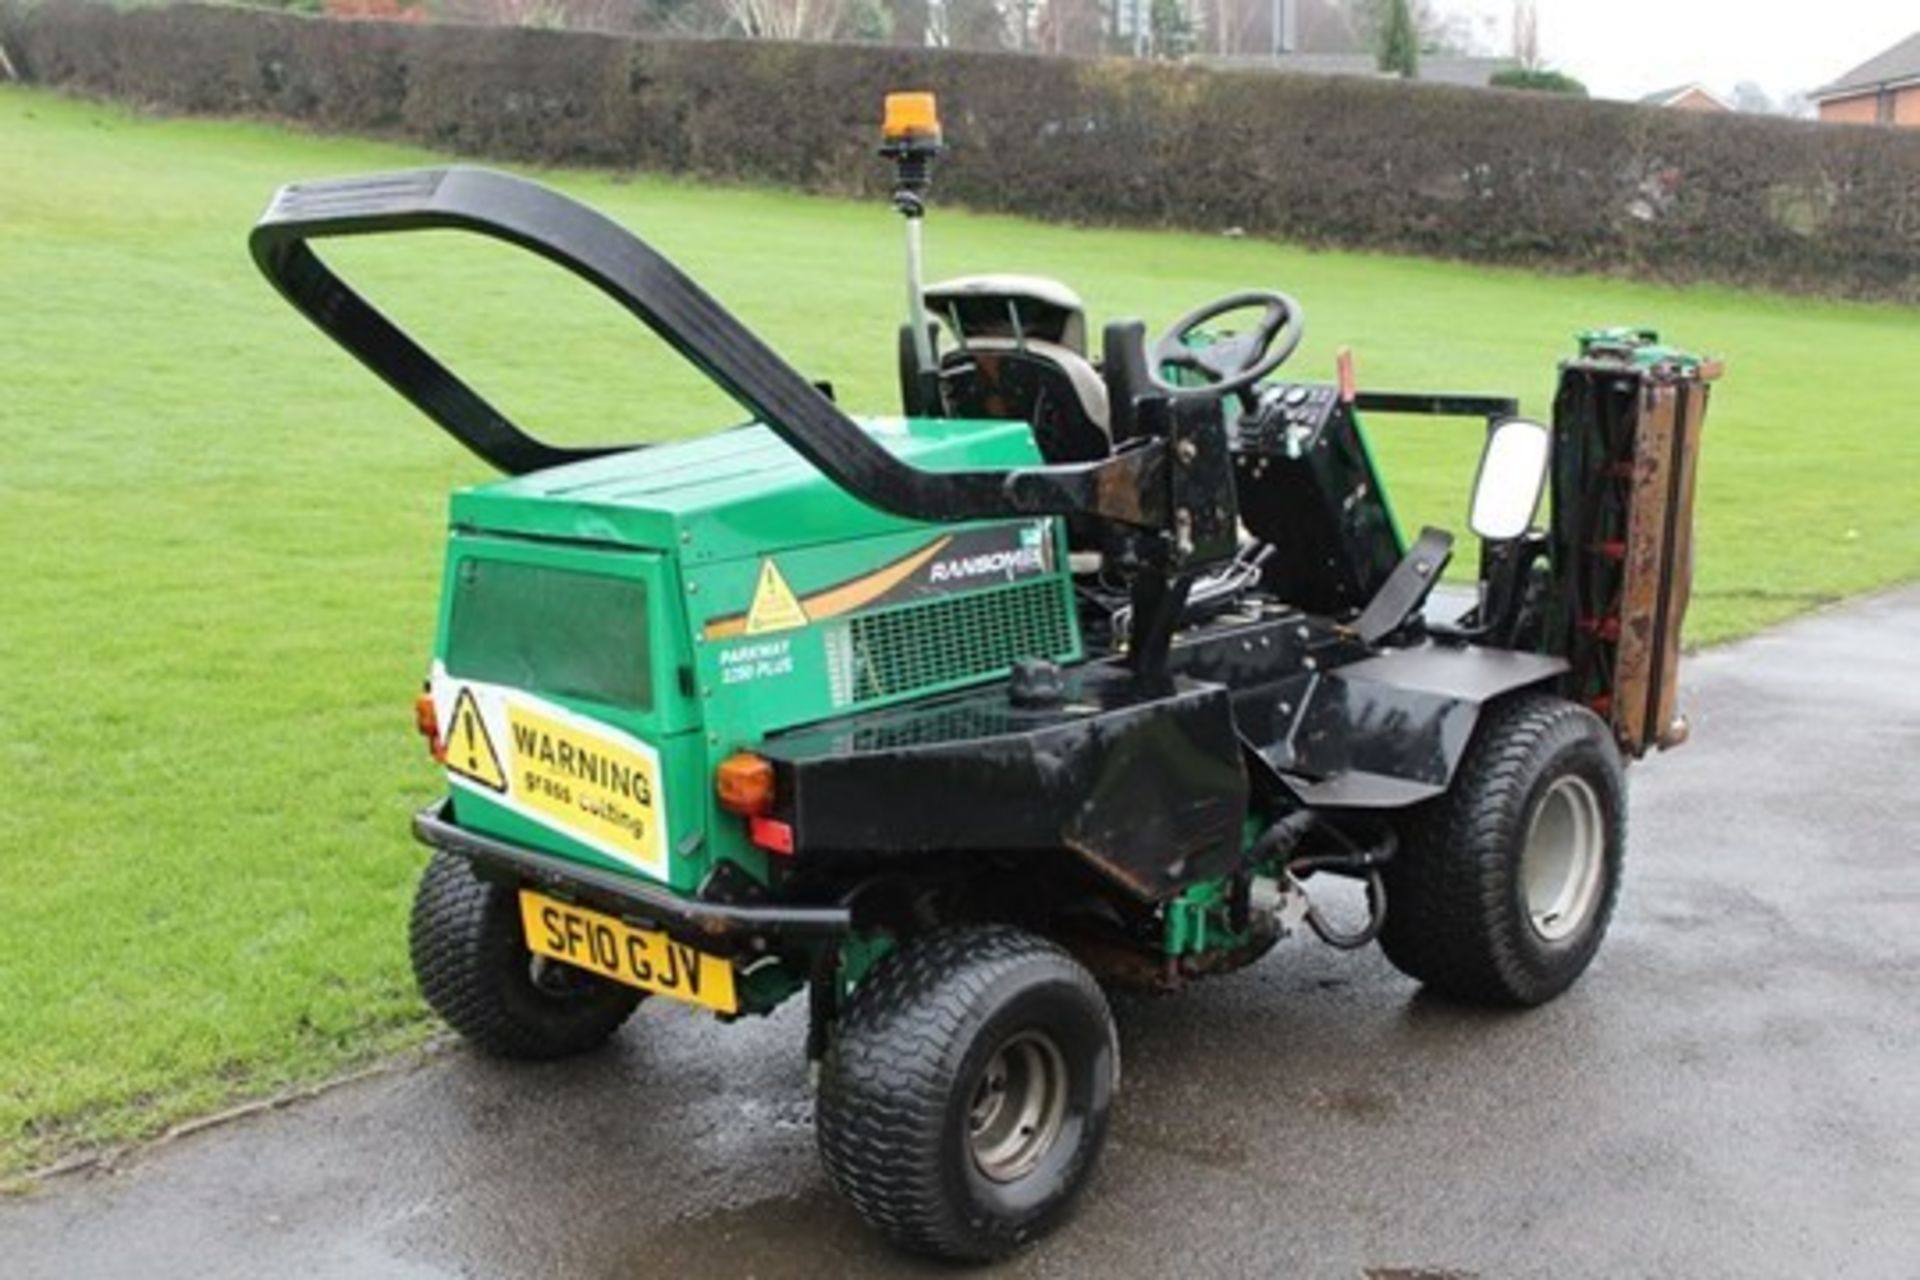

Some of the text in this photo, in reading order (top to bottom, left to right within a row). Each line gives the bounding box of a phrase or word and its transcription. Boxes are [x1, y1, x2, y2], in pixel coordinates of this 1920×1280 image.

[719, 640, 790, 665] PARKWAY
[757, 657, 794, 679] PLUS
[511, 722, 651, 806] WARNING
[525, 771, 645, 840] grass cutting
[542, 906, 700, 995] SF10 GJV
